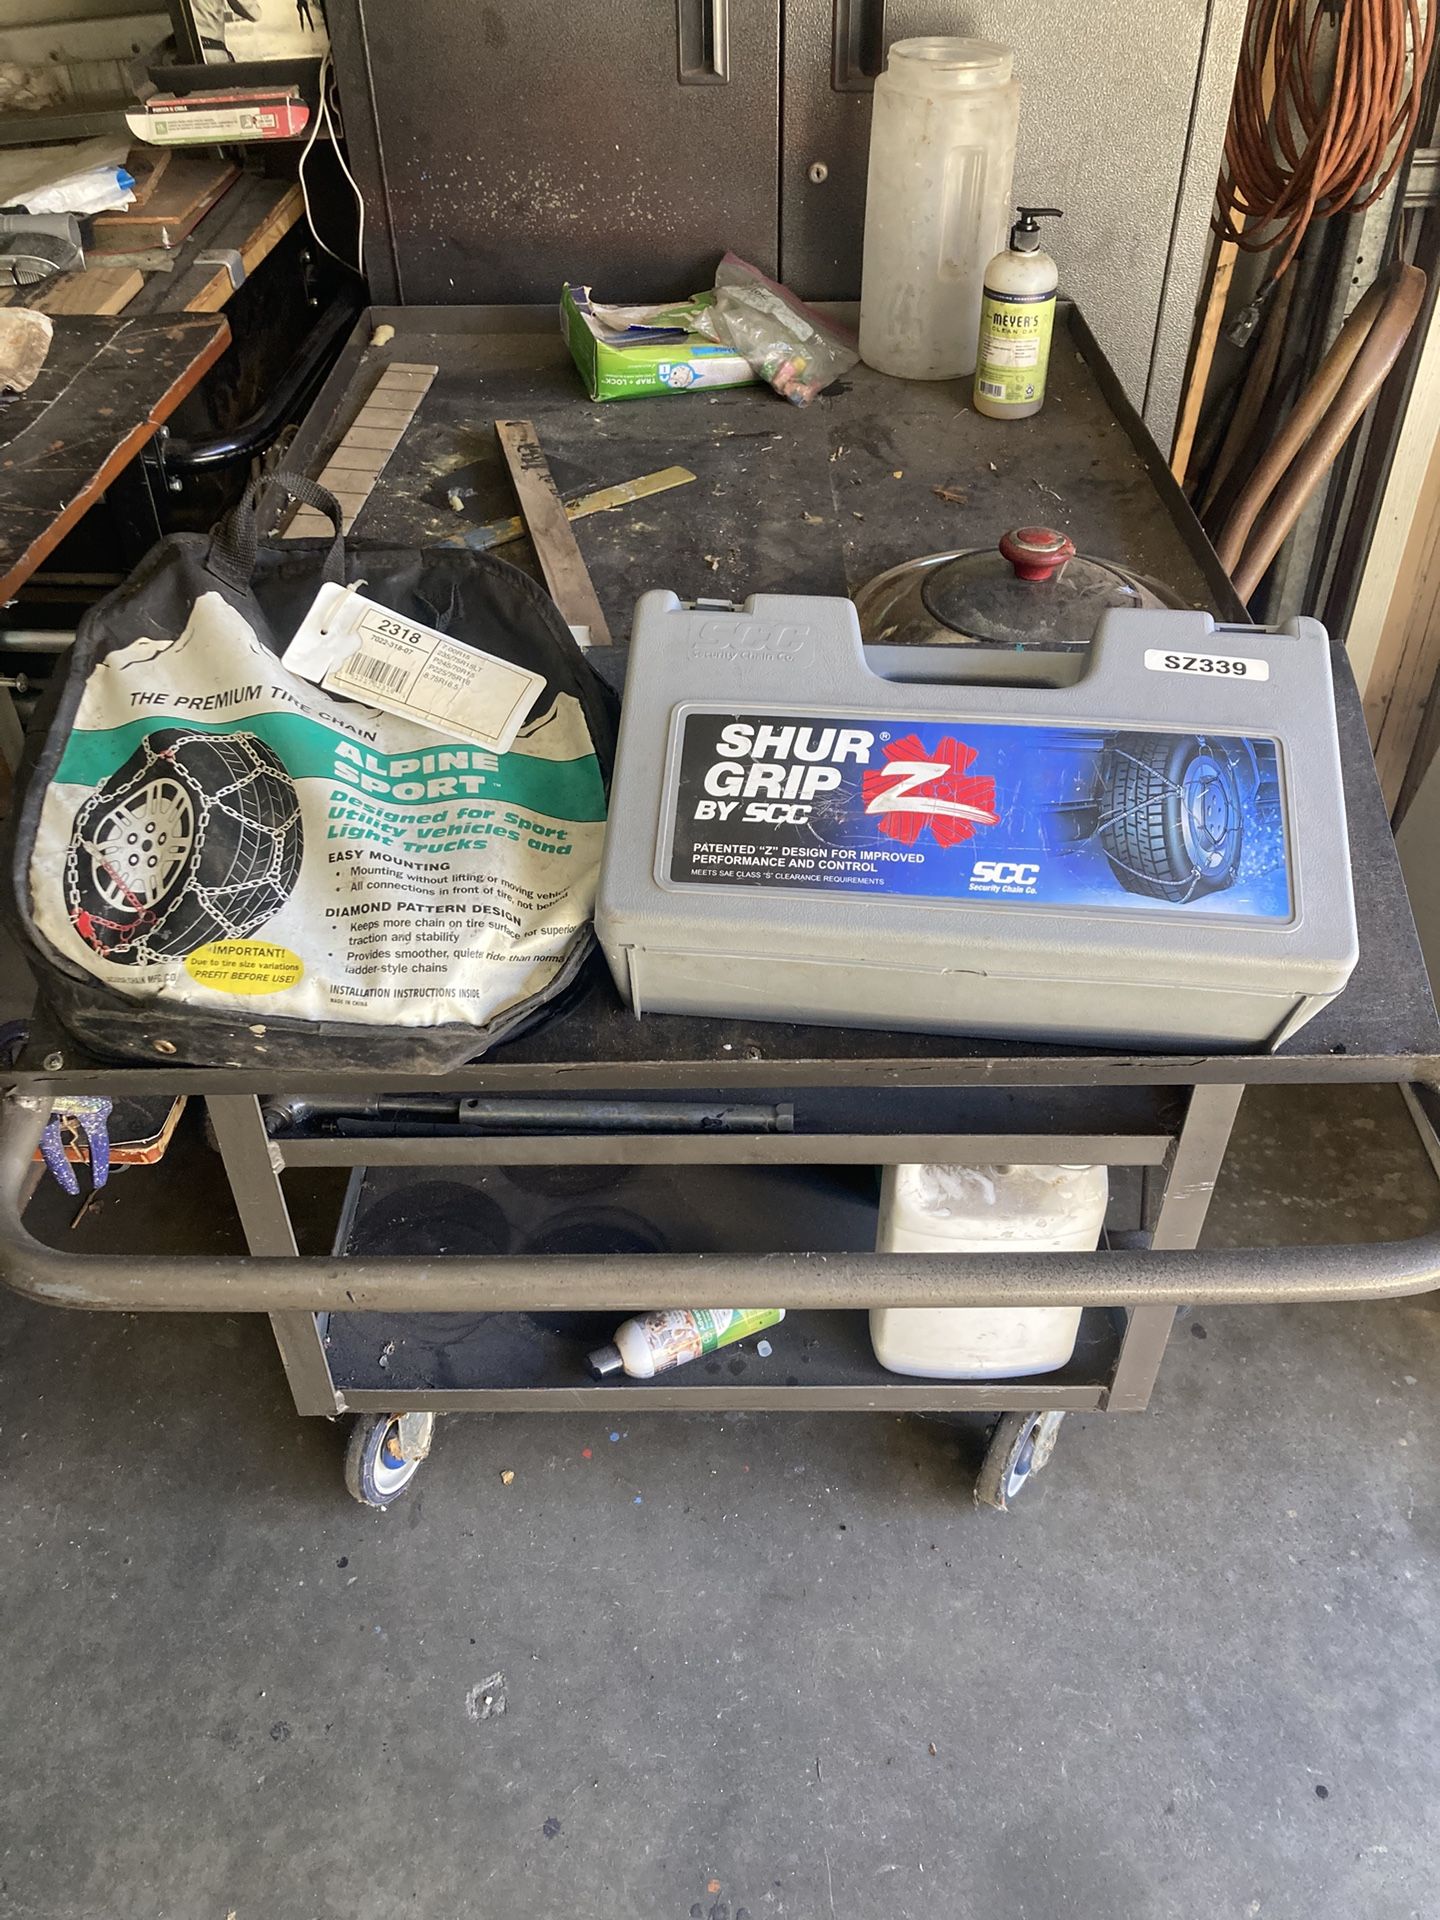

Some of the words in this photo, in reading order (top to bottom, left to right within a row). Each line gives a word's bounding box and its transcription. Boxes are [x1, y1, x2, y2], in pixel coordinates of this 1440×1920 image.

[993, 313, 1038, 328] MEYER'S
[378, 619, 422, 644] 2318
[370, 634, 414, 656] 7022-318-07
[1164, 655, 1247, 676] SZ339
[130, 692, 170, 707] THE
[174, 685, 262, 710] PREMIUM
[270, 686, 312, 714] TIRE
[318, 711, 378, 742] CHAIN
[334, 740, 499, 778] ALPINE
[704, 761, 842, 800] GRIP
[865, 761, 1000, 825] Z
[330, 790, 448, 824] Designed
[456, 808, 496, 820] for
[504, 812, 568, 841] Sport
[694, 800, 739, 821] BY
[742, 803, 814, 824] SCC
[328, 806, 408, 838] Utility
[528, 838, 572, 855] and
[328, 824, 394, 846] Light
[403, 838, 488, 854] Trucks
[328, 850, 364, 864] EASY
[369, 850, 450, 871] MOUNTING
[692, 855, 786, 867] PERFORMANCE
[788, 859, 816, 868] AND
[818, 860, 878, 873] CONTROL
[694, 843, 756, 855] PATENTED
[782, 847, 829, 858] DESIGN
[832, 850, 857, 860] FOR
[860, 851, 925, 863] IMPROVED
[350, 866, 404, 880] Mounting
[406, 874, 448, 884] without
[452, 873, 484, 883] lifting
[501, 878, 534, 900] moving
[690, 869, 718, 877] MEETS
[719, 870, 734, 878] SAE
[736, 871, 761, 879] CLASS
[775, 873, 821, 882] CLEARANCE
[823, 876, 884, 886] REQUIREMENTS
[970, 861, 1040, 885] SCC
[350, 881, 363, 892] All
[366, 882, 436, 896] connections
[440, 888, 448, 896] in
[453, 886, 480, 894] front
[483, 886, 494, 894] of
[517, 900, 533, 911] not
[968, 883, 1001, 893] Security
[1002, 885, 1024, 894] Chain
[326, 902, 392, 918] DIAMOND
[397, 902, 466, 914] PATTERN
[472, 904, 522, 926] DESIGN
[348, 933, 388, 946] traction
[392, 932, 412, 942] and
[416, 931, 460, 944] stability
[350, 920, 380, 932] Keeps
[383, 919, 411, 928] more
[415, 918, 445, 928] chain
[448, 920, 462, 928] on
[466, 919, 485, 928] tire
[488, 921, 520, 940] surface
[212, 944, 286, 958] IMPORTANT!
[346, 949, 391, 961] Provides
[394, 948, 449, 959] smoother,
[486, 951, 506, 962] ride
[190, 958, 208, 966] Due
[223, 959, 236, 967] tire
[239, 960, 256, 968] size
[258, 962, 300, 971] variations
[412, 962, 448, 973] chains
[194, 970, 228, 980] PREFIT
[231, 971, 269, 982] BEFORE
[272, 974, 296, 983] USE!
[330, 984, 390, 998] INSTALLATION
[394, 988, 456, 998] INSTRUCTIONS
[459, 989, 480, 998] INSIDE
